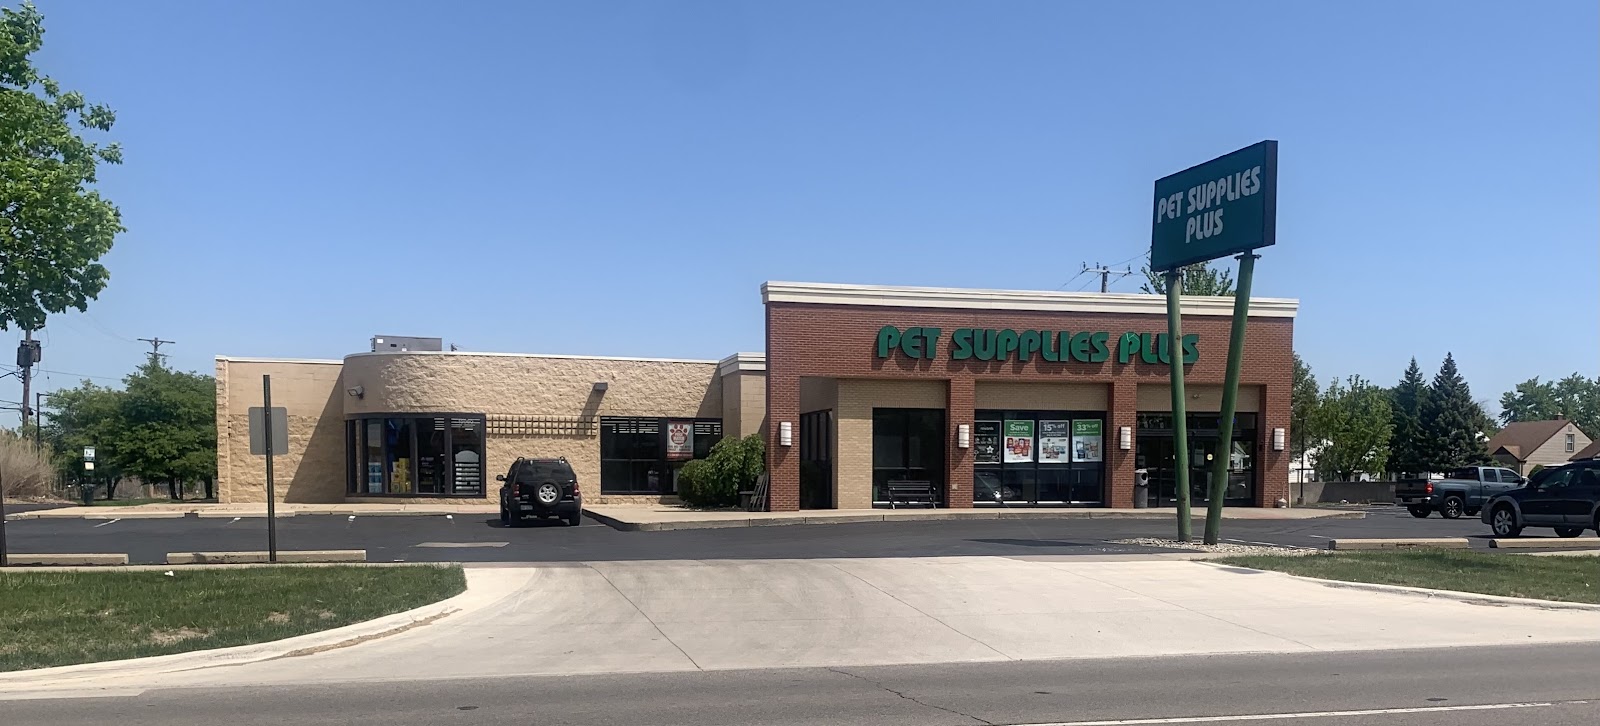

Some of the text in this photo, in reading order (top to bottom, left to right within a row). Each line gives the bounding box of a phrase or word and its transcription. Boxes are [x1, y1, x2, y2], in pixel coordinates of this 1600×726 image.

[1157, 165, 1261, 224] PET SUPPLIES
[1185, 208, 1224, 244] PLUS
[877, 325, 941, 358] PET
[952, 328, 1110, 363] SUPPLIES
